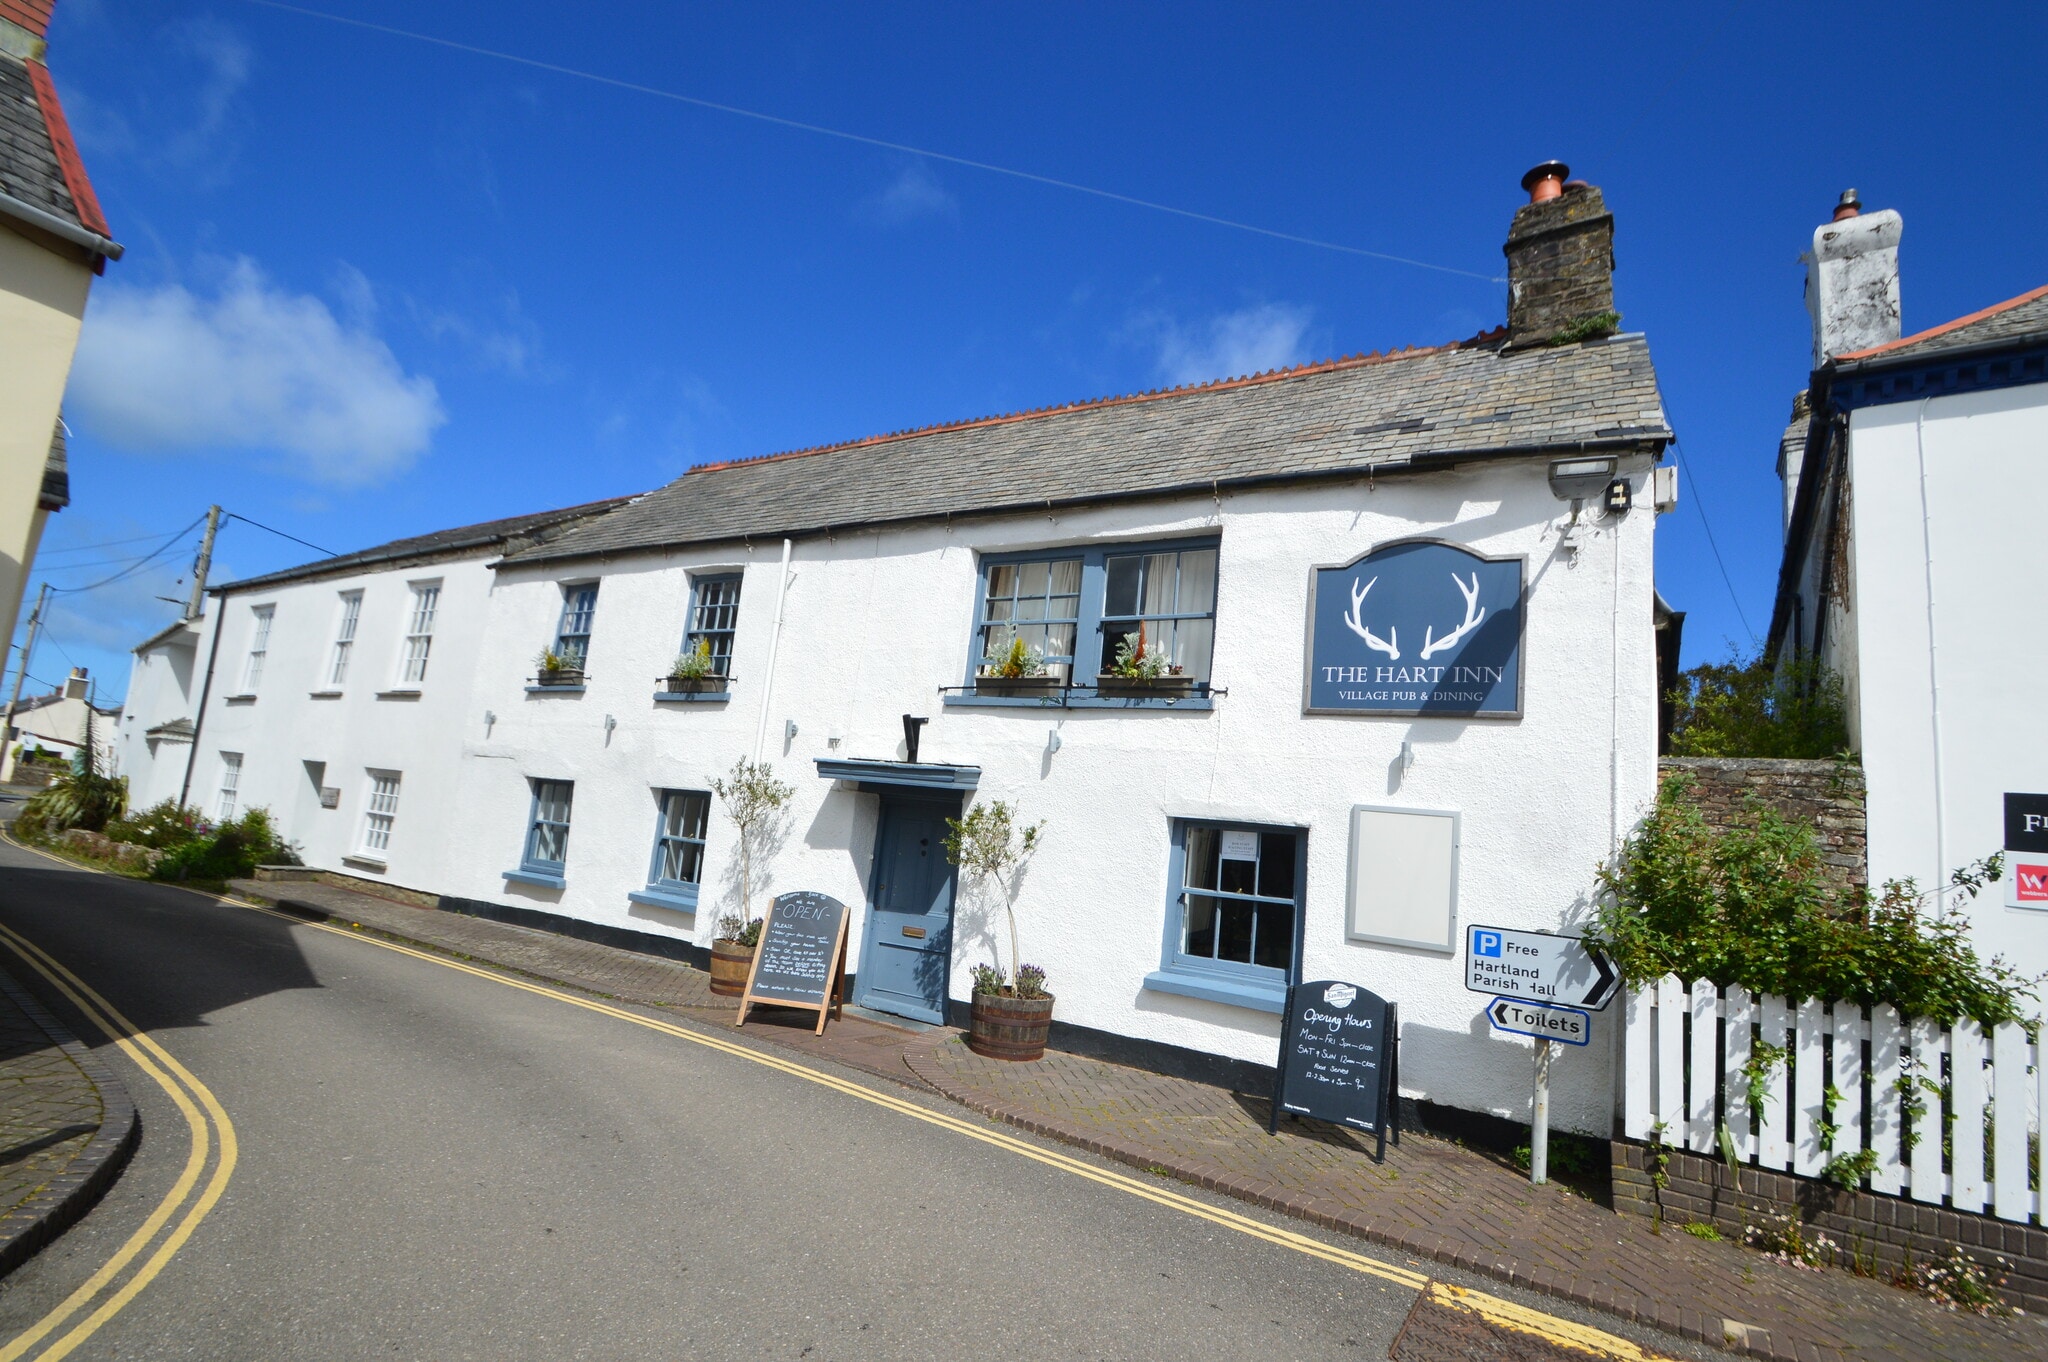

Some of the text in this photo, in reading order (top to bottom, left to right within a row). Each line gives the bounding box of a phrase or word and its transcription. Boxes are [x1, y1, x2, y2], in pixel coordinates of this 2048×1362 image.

[1322, 666, 1504, 683] THE HART INN
[1338, 690, 1484, 701] VILLAGE PUB & DINING
[782, 904, 828, 920] OPEN
[1480, 933, 1539, 956] P Free
[1474, 959, 1539, 979] Hartland
[1474, 973, 1519, 990] Parish
[1304, 1008, 1372, 1032] Opening Hours
[1511, 1008, 1580, 1033] Toilets
